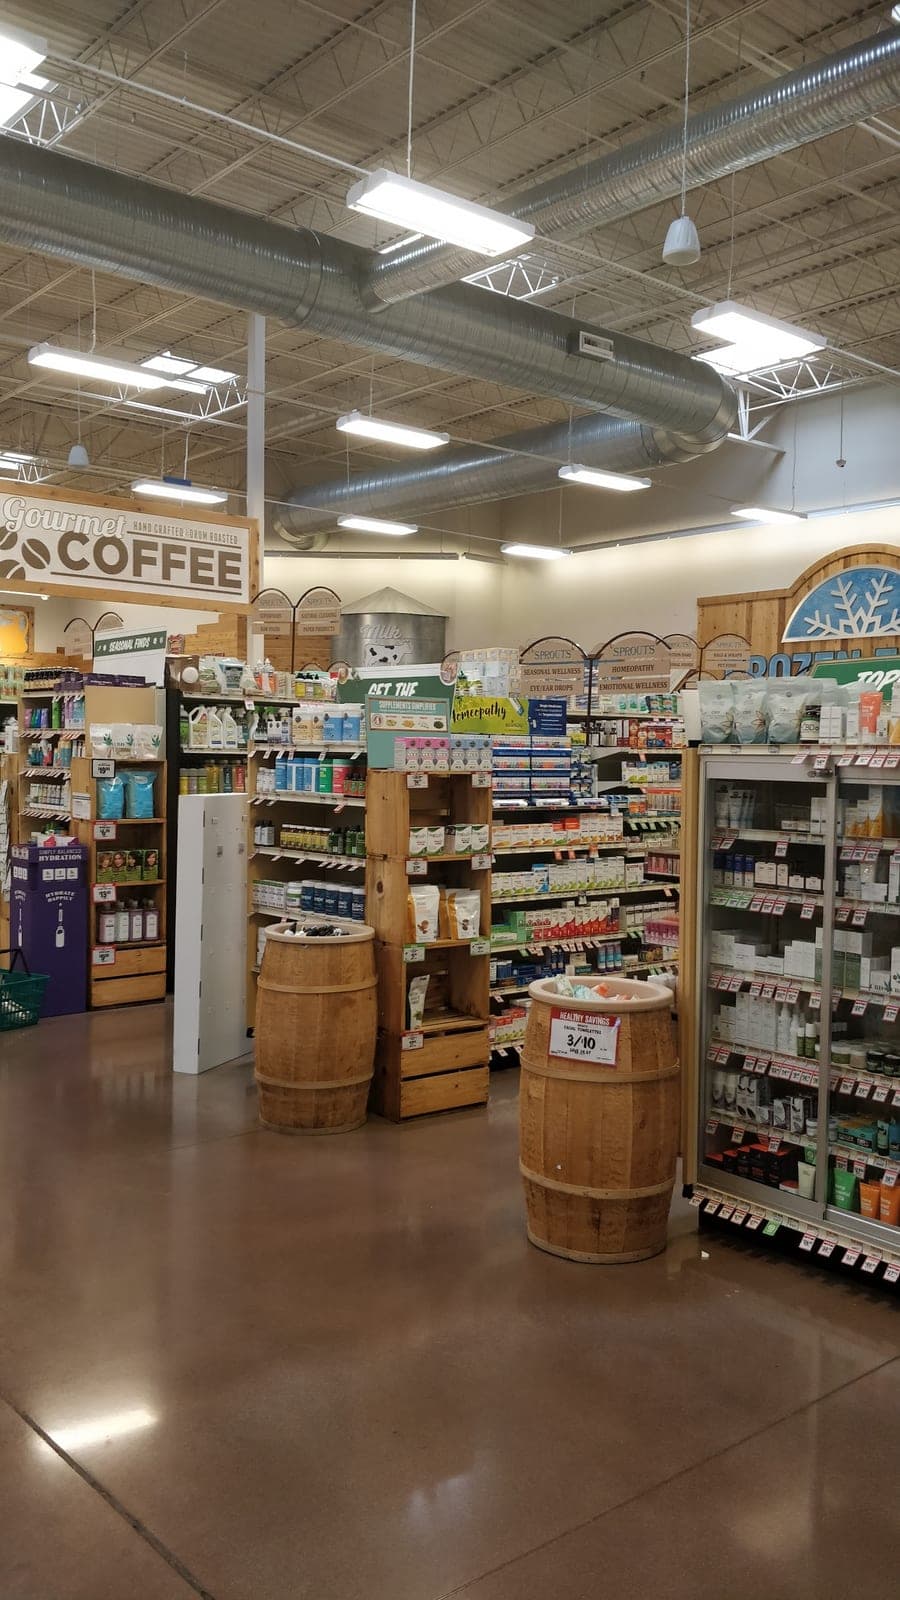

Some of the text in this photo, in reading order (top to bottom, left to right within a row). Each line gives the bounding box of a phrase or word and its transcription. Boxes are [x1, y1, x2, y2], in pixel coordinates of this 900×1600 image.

[3, 497, 127, 539] Gourmet
[133, 521, 152, 533] HAND
[154, 523, 184, 537] CRAFTED
[190, 528, 208, 538] DRUM
[210, 532, 238, 544] ROASTED
[57, 531, 242, 589] COFFEE
[360, 624, 402, 639] Milk
[109, 637, 150, 652] SEASONAL FINDS
[613, 645, 655, 657] SPROUTS
[534, 650, 572, 660] SPROUTS
[552, 668, 581, 676] WELLNESS
[612, 664, 654, 673] HOMEOPATHY
[395, 682, 418, 696] THE
[600, 681, 668, 690] EMOTIONAL WELLNESS
[560, 1012, 610, 1026] HEALTHY SAVINGS
